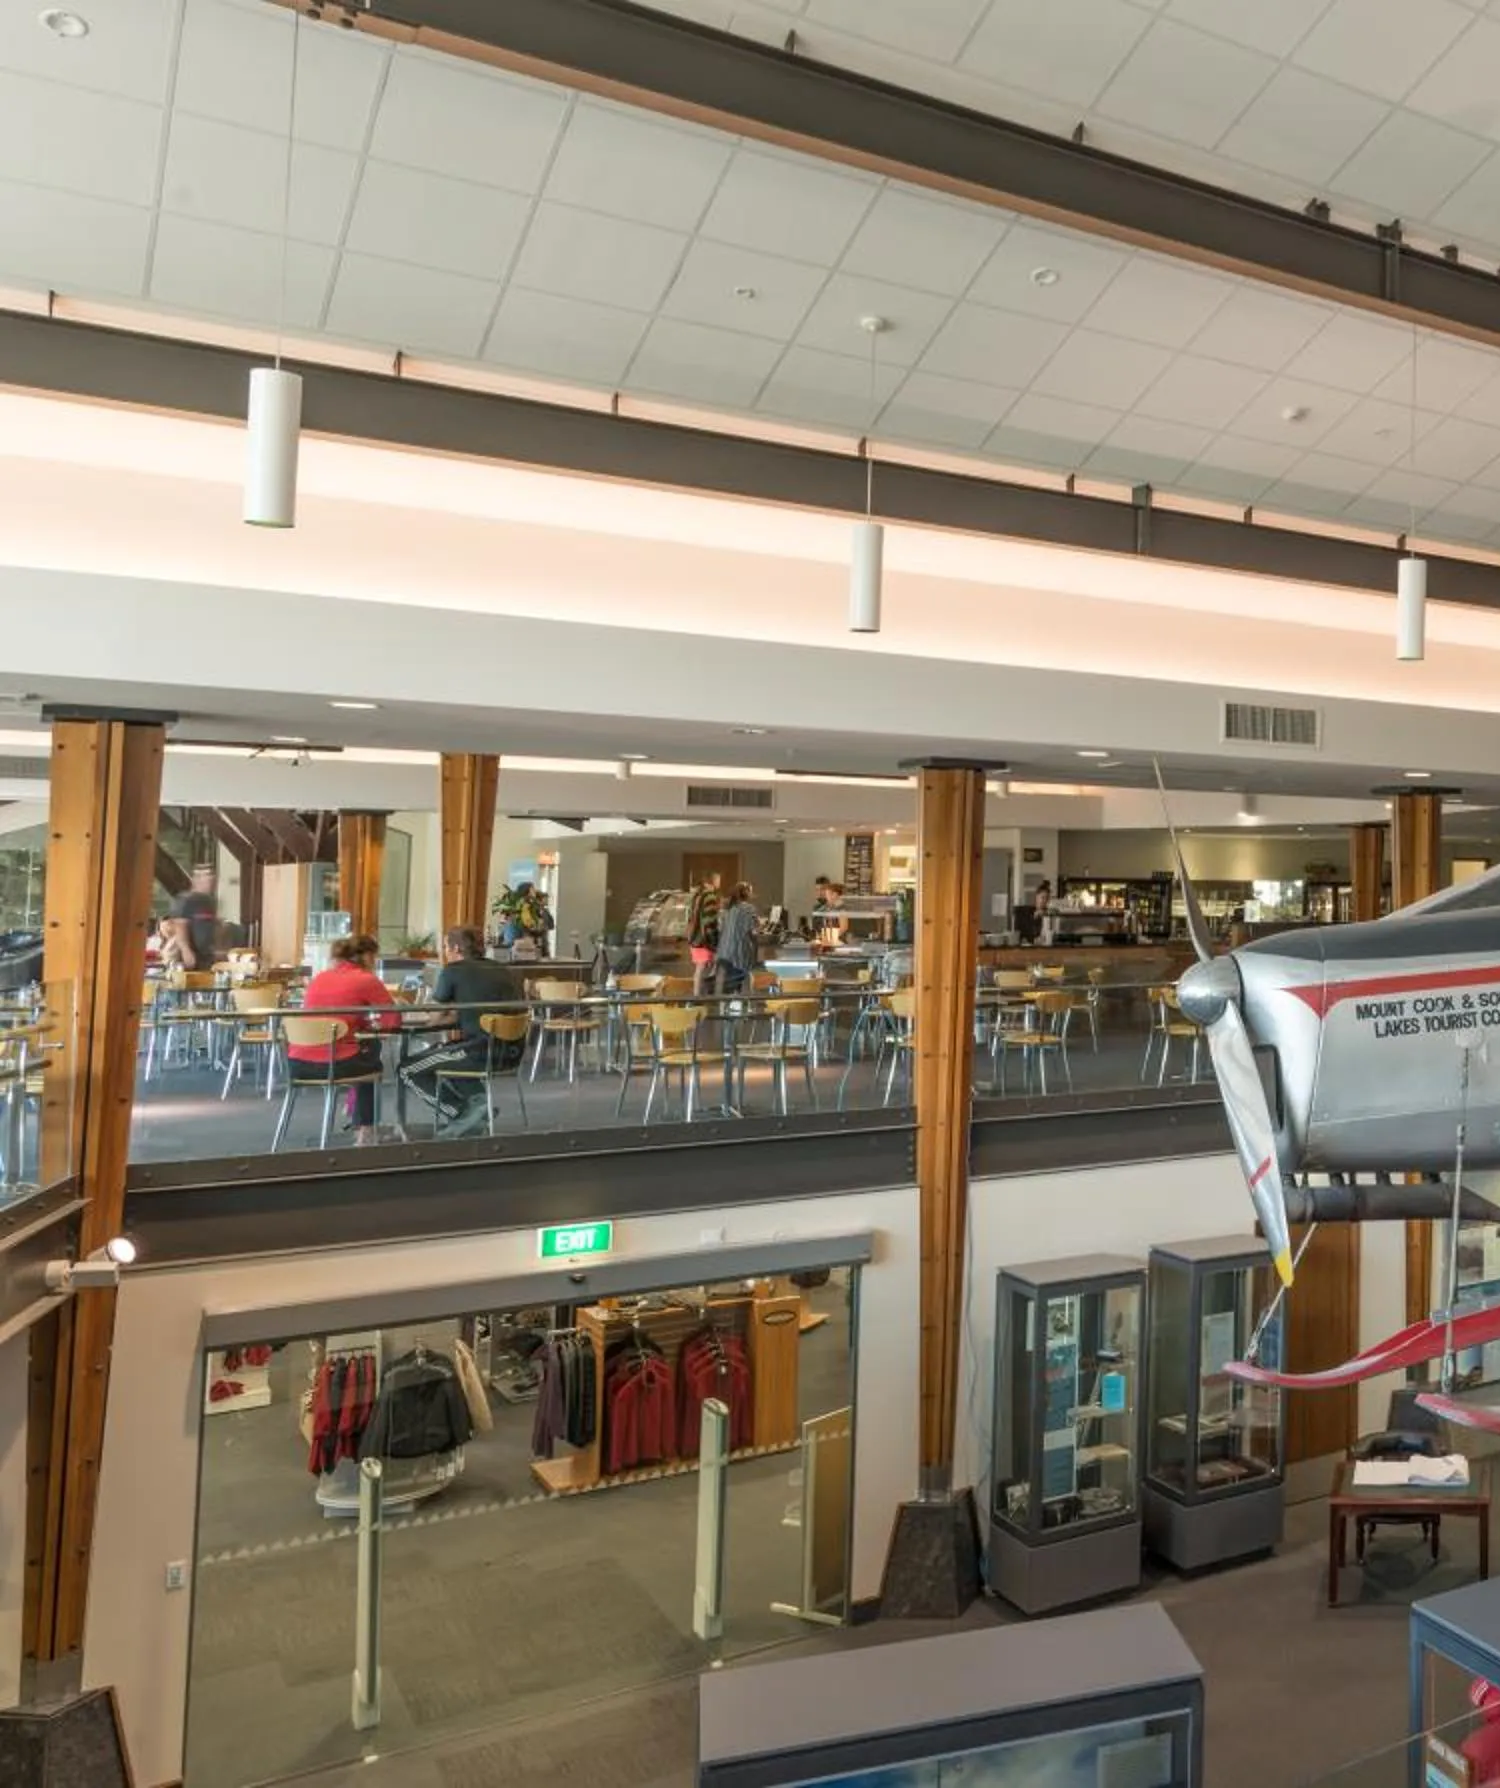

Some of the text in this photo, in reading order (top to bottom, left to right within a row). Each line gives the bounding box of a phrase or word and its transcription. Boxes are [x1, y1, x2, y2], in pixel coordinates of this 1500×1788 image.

[1355, 1001, 1406, 1021] MOUNT
[1413, 996, 1455, 1014] COOK
[1462, 993, 1472, 1009] &
[1374, 1020, 1421, 1038] LAKES
[1424, 1011, 1479, 1033] TOURIST
[555, 1228, 597, 1252] EXIT
